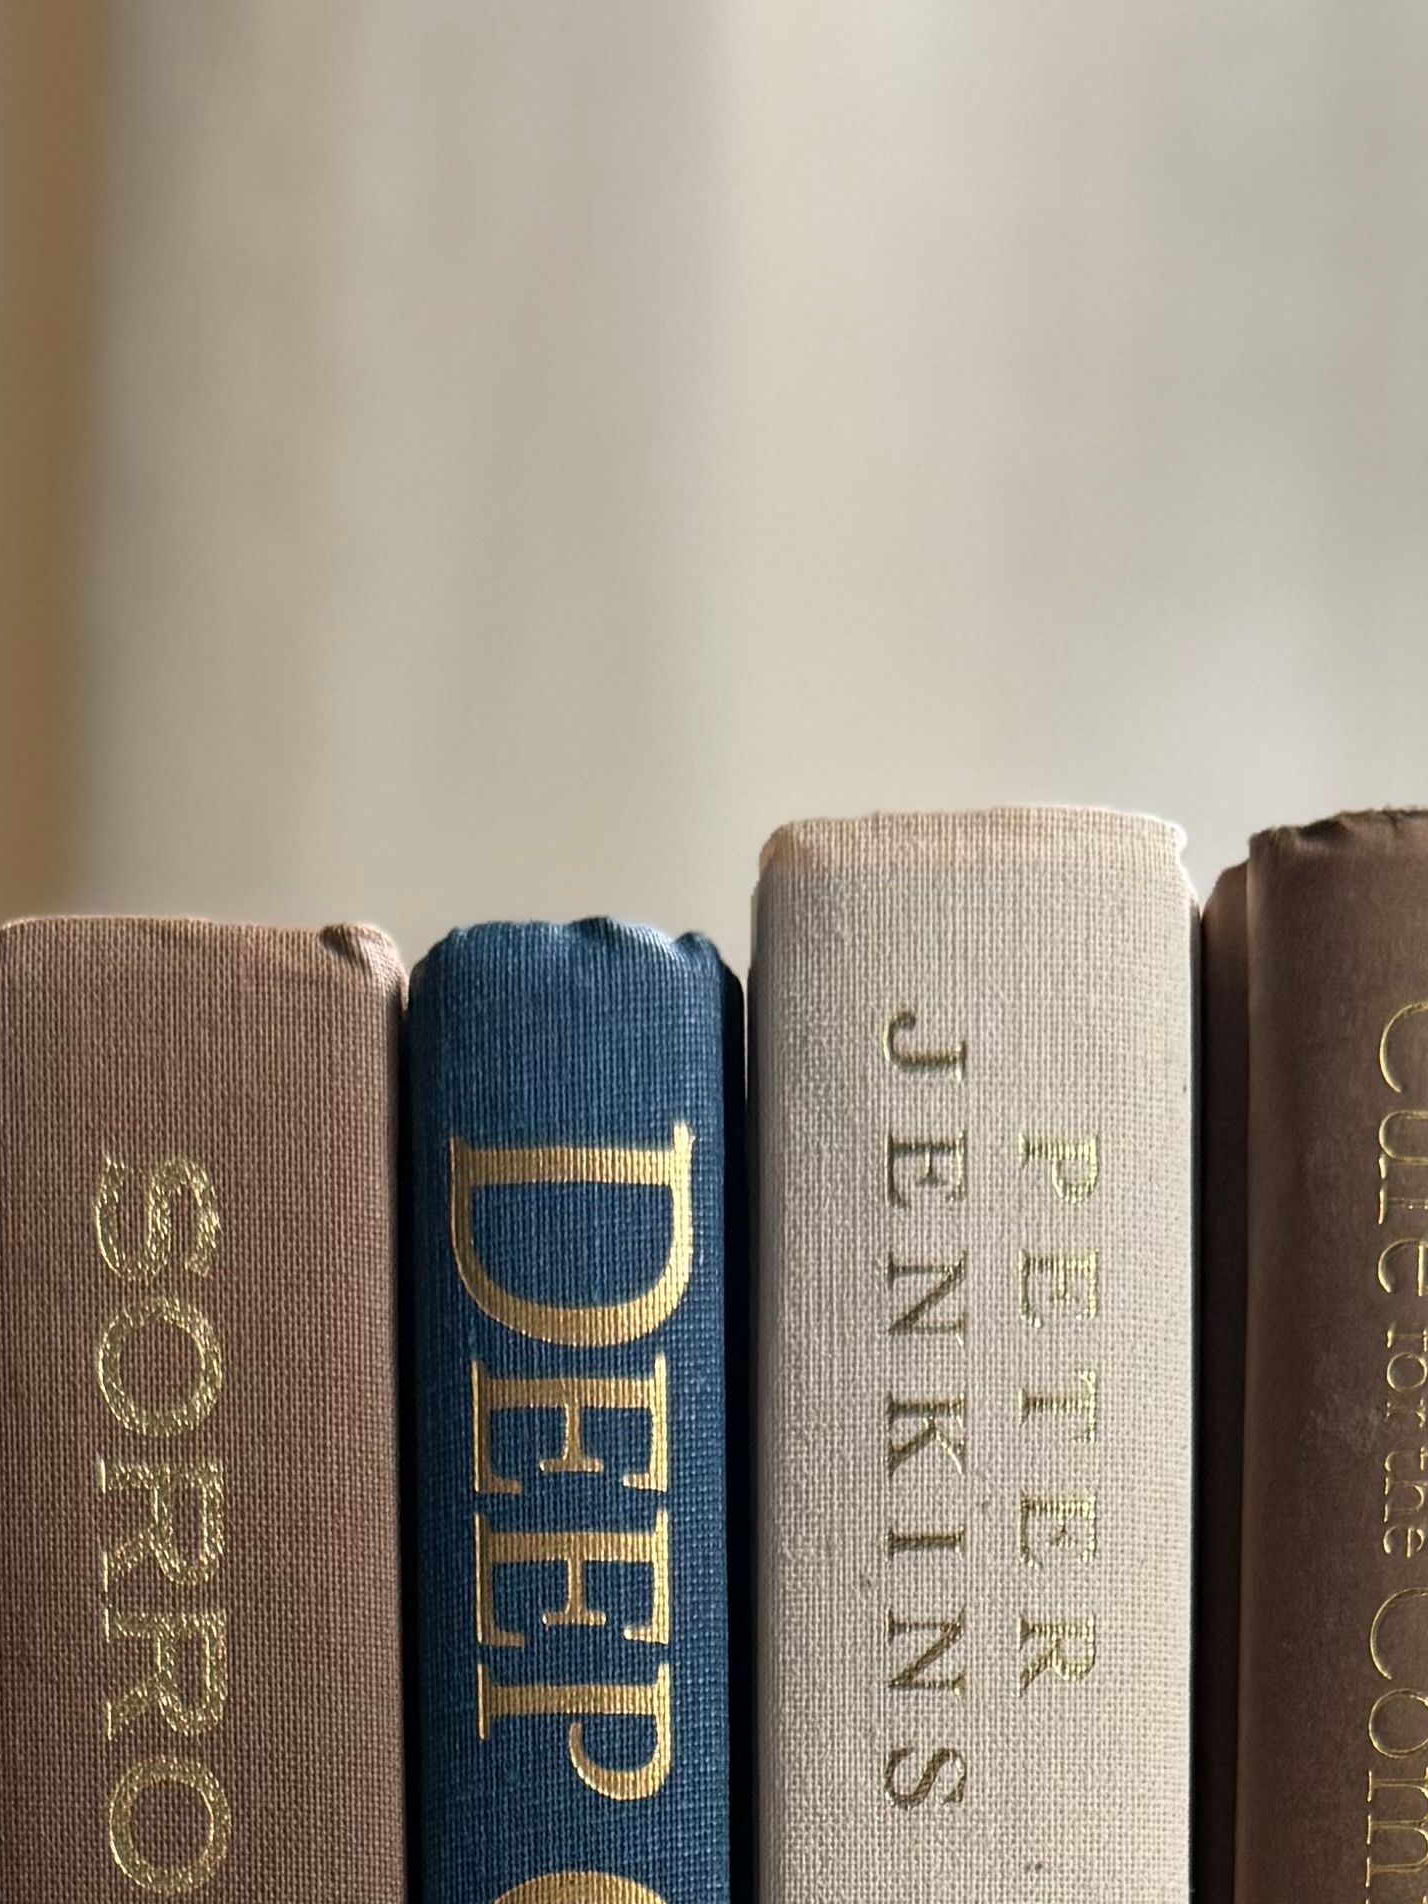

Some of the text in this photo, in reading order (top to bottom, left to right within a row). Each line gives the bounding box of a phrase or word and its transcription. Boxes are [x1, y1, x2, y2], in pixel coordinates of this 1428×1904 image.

[448, 1120, 694, 1802] DEEP
[881, 1010, 969, 1813] JENKINS
[1017, 1131, 1098, 1698] PETER
